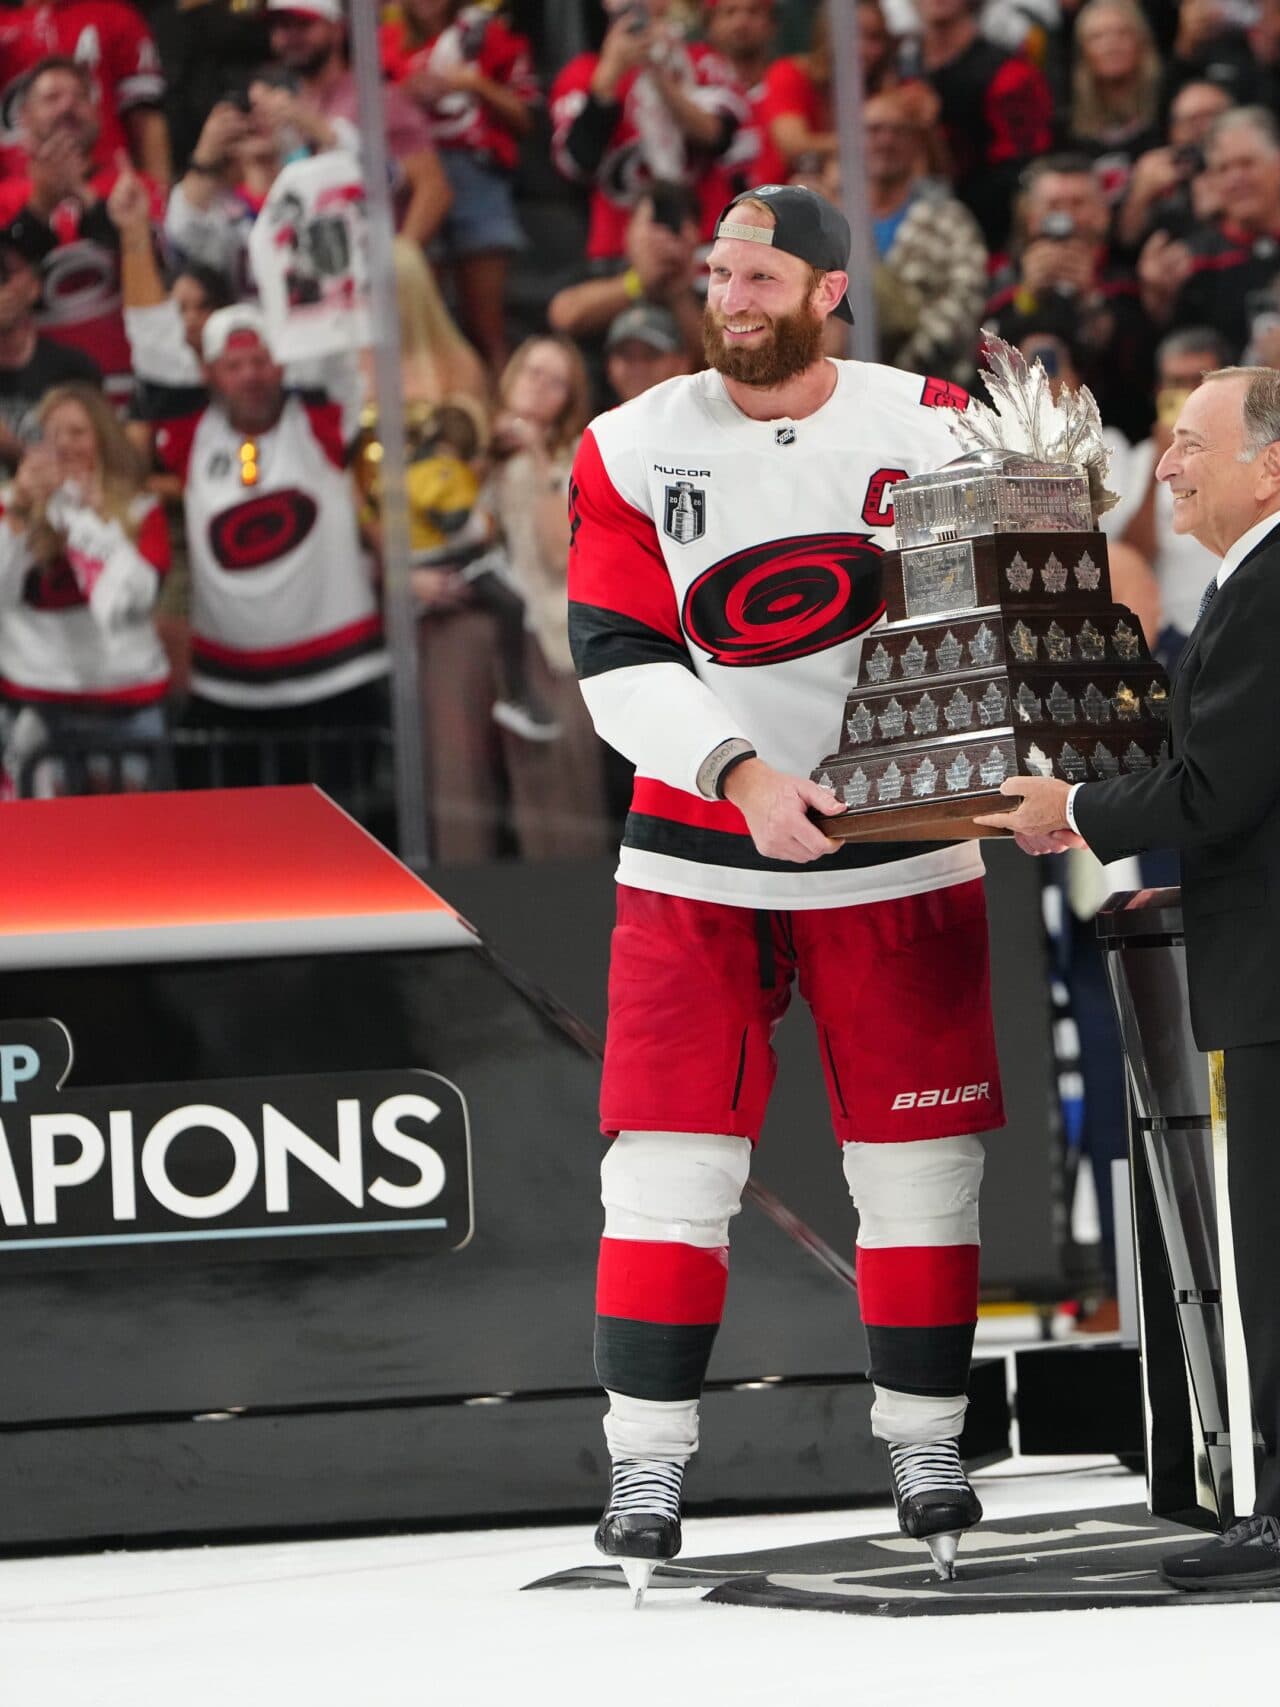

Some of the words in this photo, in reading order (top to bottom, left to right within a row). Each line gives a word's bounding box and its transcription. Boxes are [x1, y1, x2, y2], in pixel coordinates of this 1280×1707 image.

[654, 464, 711, 478] NUCOR
[861, 468, 910, 527] C
[891, 1082, 990, 1110] BAUER
